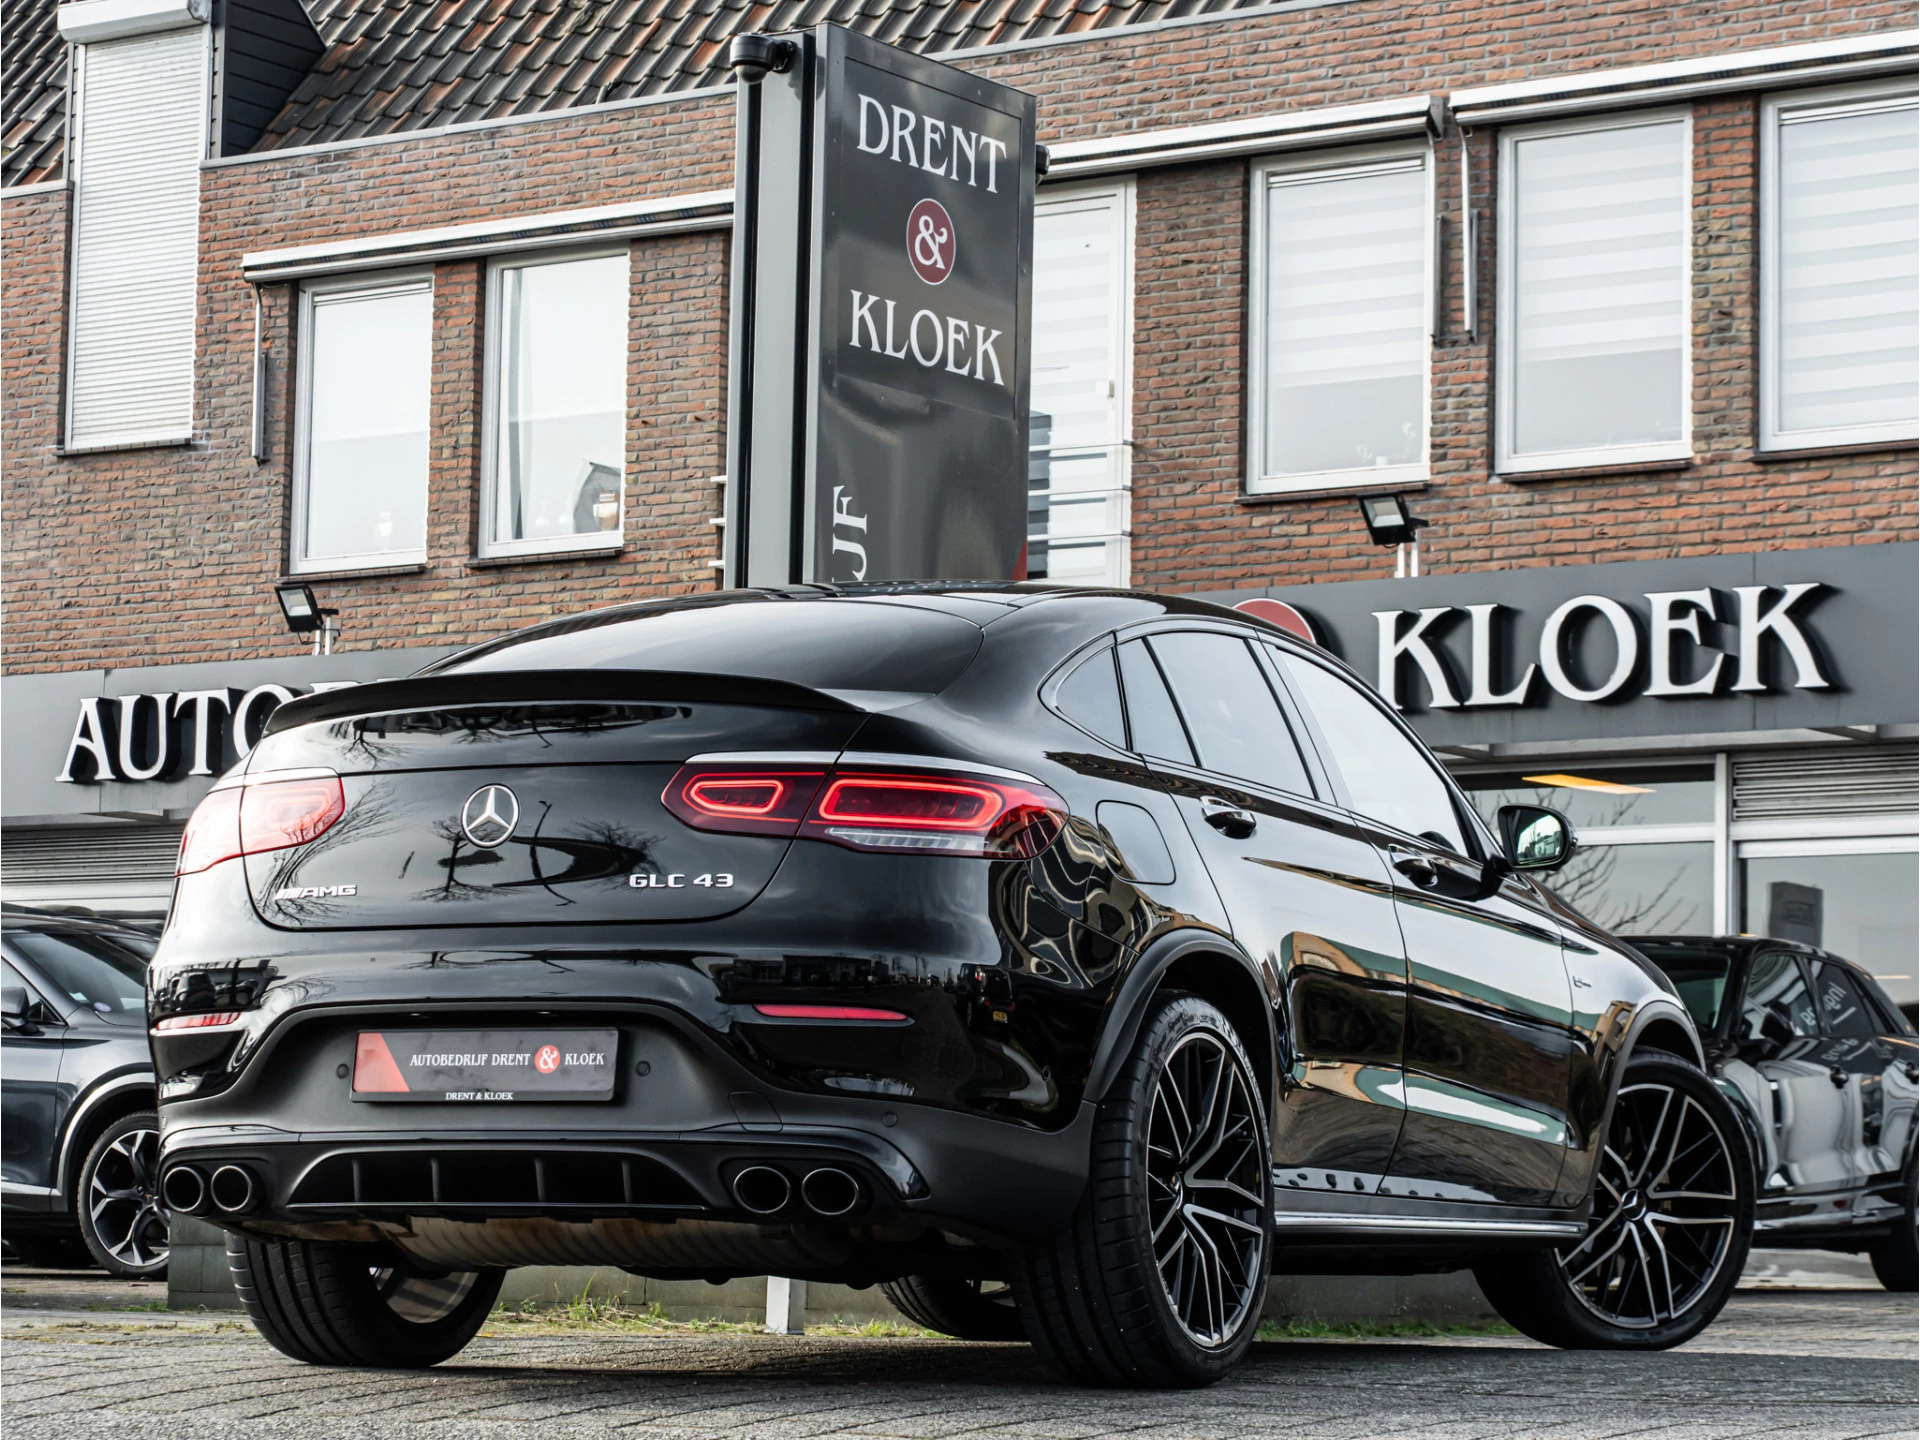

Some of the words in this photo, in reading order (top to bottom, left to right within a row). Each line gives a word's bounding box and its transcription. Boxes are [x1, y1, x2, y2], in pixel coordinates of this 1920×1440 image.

[856, 93, 1007, 194] DRENT
[914, 215, 949, 270] &
[849, 289, 1005, 387] KLOEK
[1371, 582, 1830, 710] KLOEK
[300, 885, 358, 899] AMG
[629, 873, 686, 888] GLC
[693, 873, 734, 888] 43
[410, 1053, 489, 1067] AUTOBEDRIJF
[491, 1053, 531, 1066] DRENT
[538, 1047, 558, 1070] &
[564, 1053, 605, 1066] KLOEK
[445, 1092, 475, 1101] DRENT
[475, 1092, 482, 1100] &
[484, 1091, 514, 1100] KLOEK
